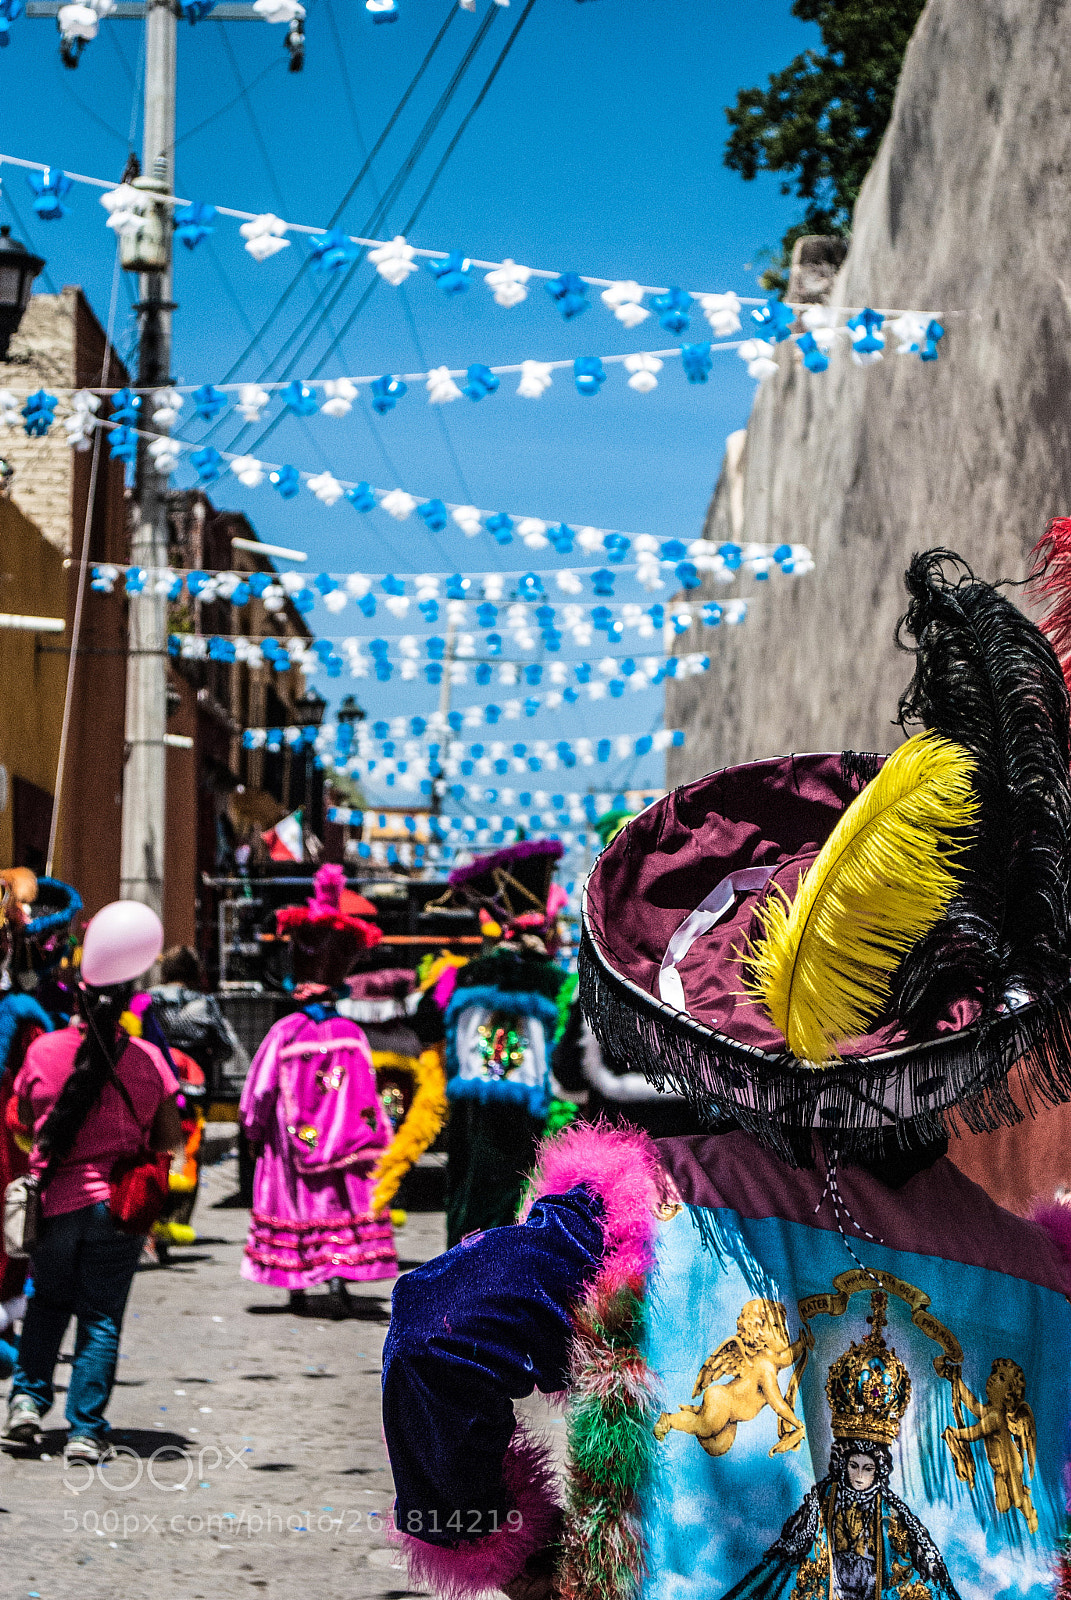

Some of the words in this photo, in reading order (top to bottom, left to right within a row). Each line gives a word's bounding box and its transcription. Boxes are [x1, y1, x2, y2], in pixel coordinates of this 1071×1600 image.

[801, 1299, 829, 1317] MATER
[899, 1283, 917, 1302] ORA
[921, 1317, 940, 1333] PRO
